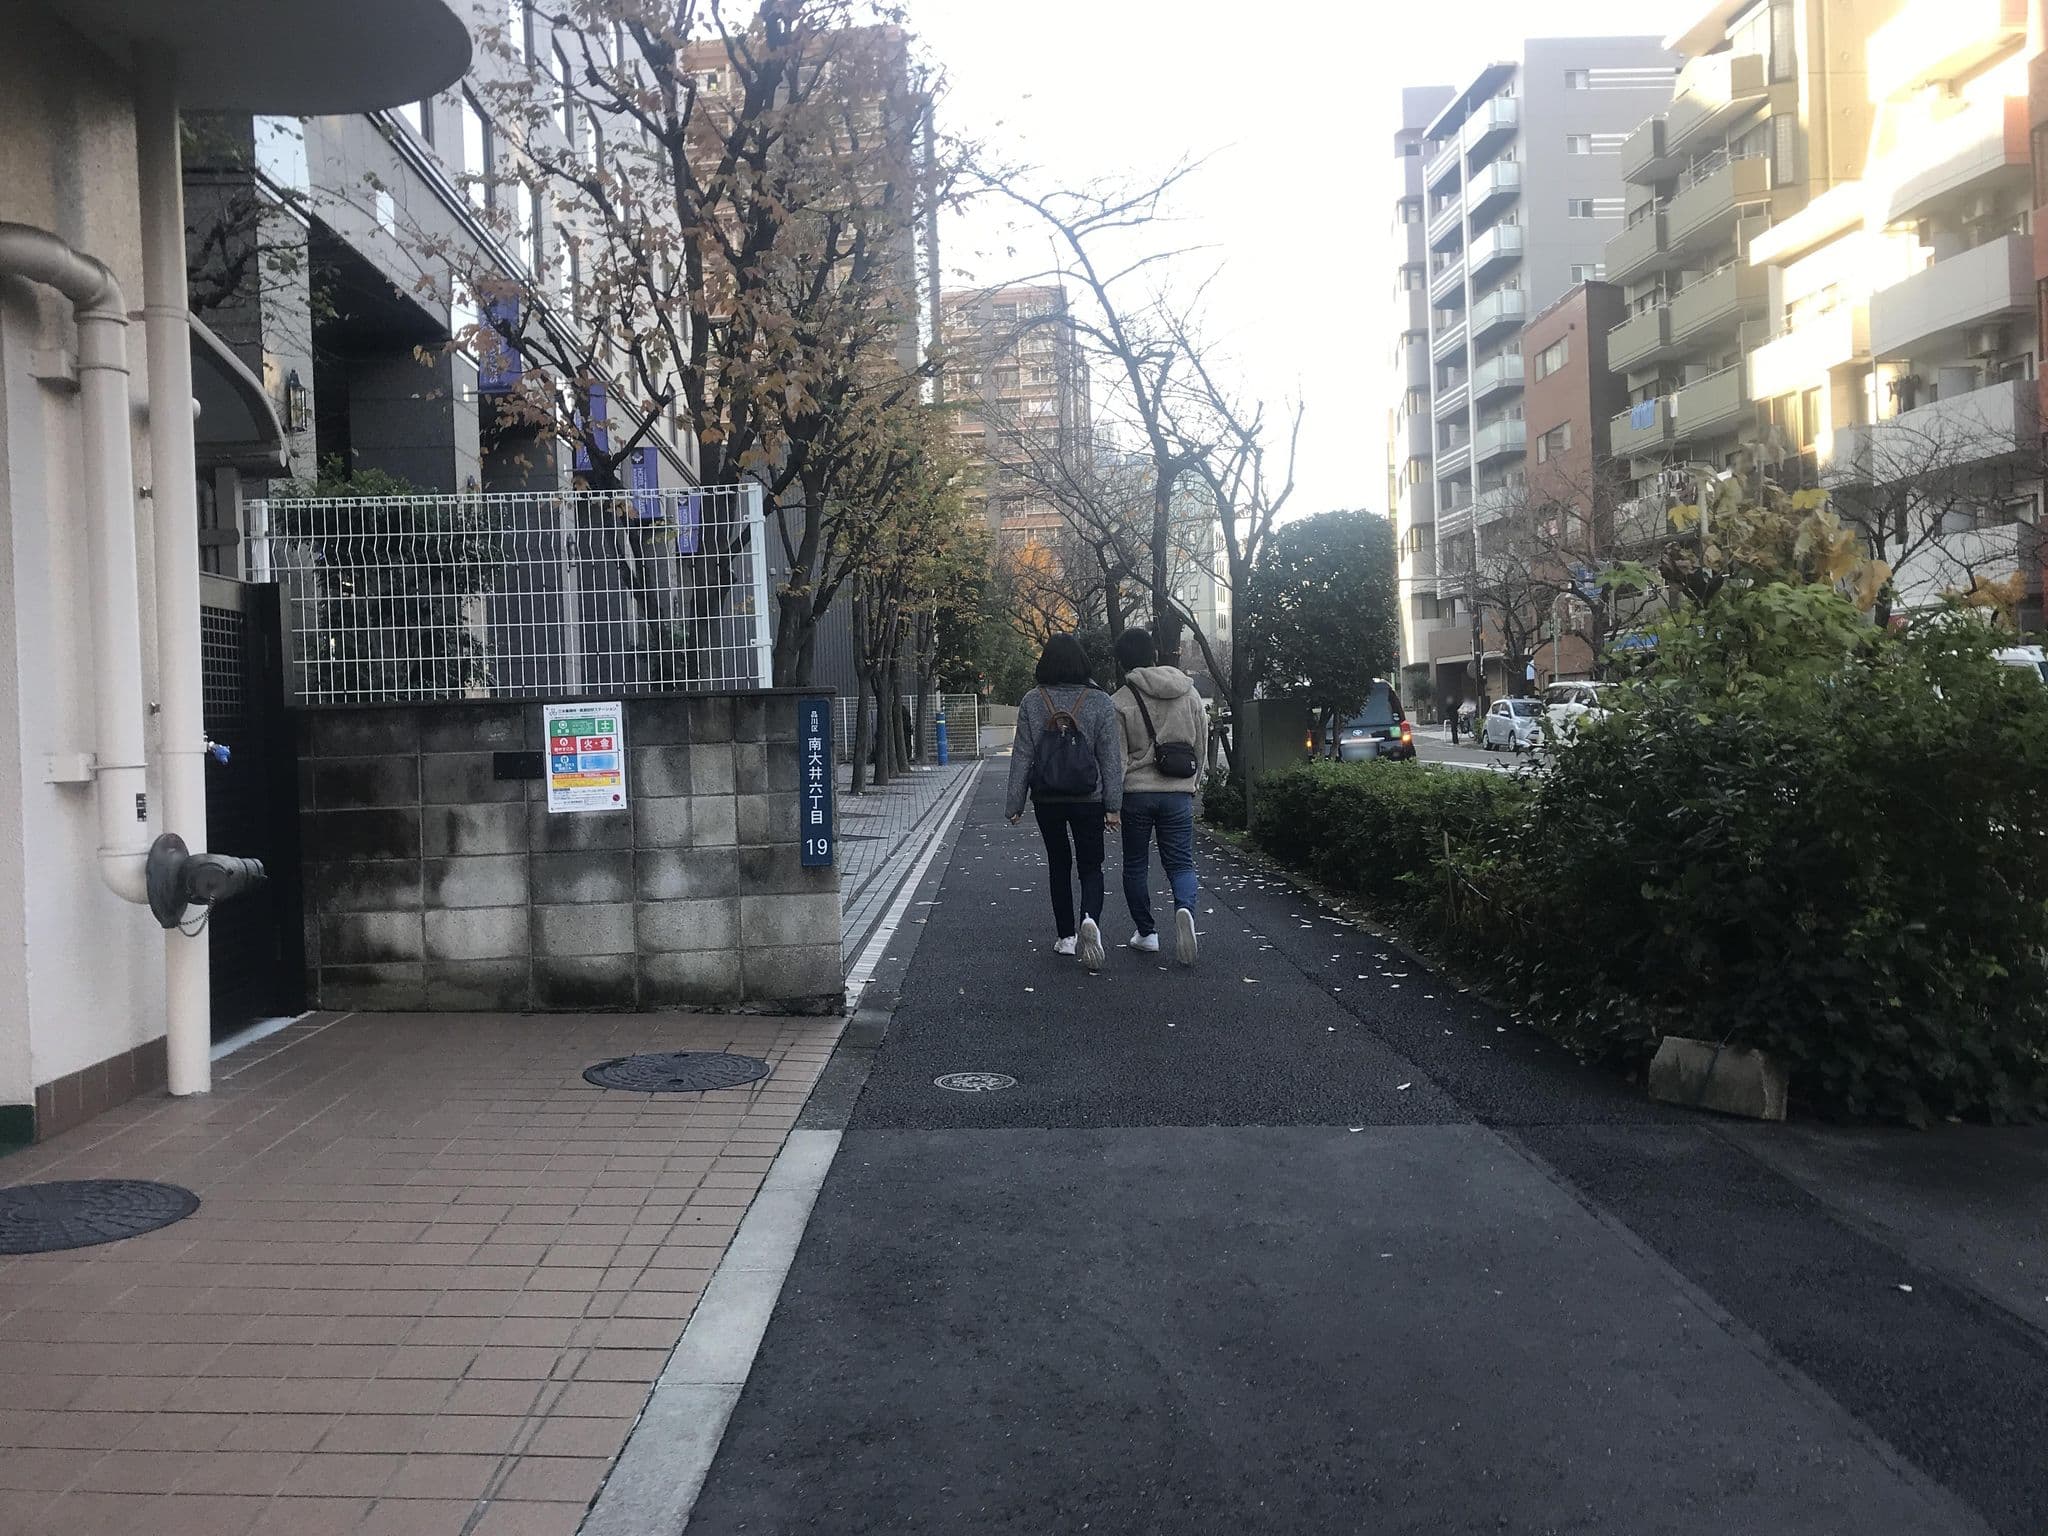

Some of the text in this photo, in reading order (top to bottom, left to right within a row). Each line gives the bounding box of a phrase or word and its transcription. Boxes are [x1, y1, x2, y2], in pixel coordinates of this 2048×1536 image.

[600, 720, 610, 730] 土
[810, 710, 819, 732] 品川区
[584, 737, 610, 748] 火・金
[807, 737, 824, 825] 南大井六丁目
[806, 839, 828, 856] 19
